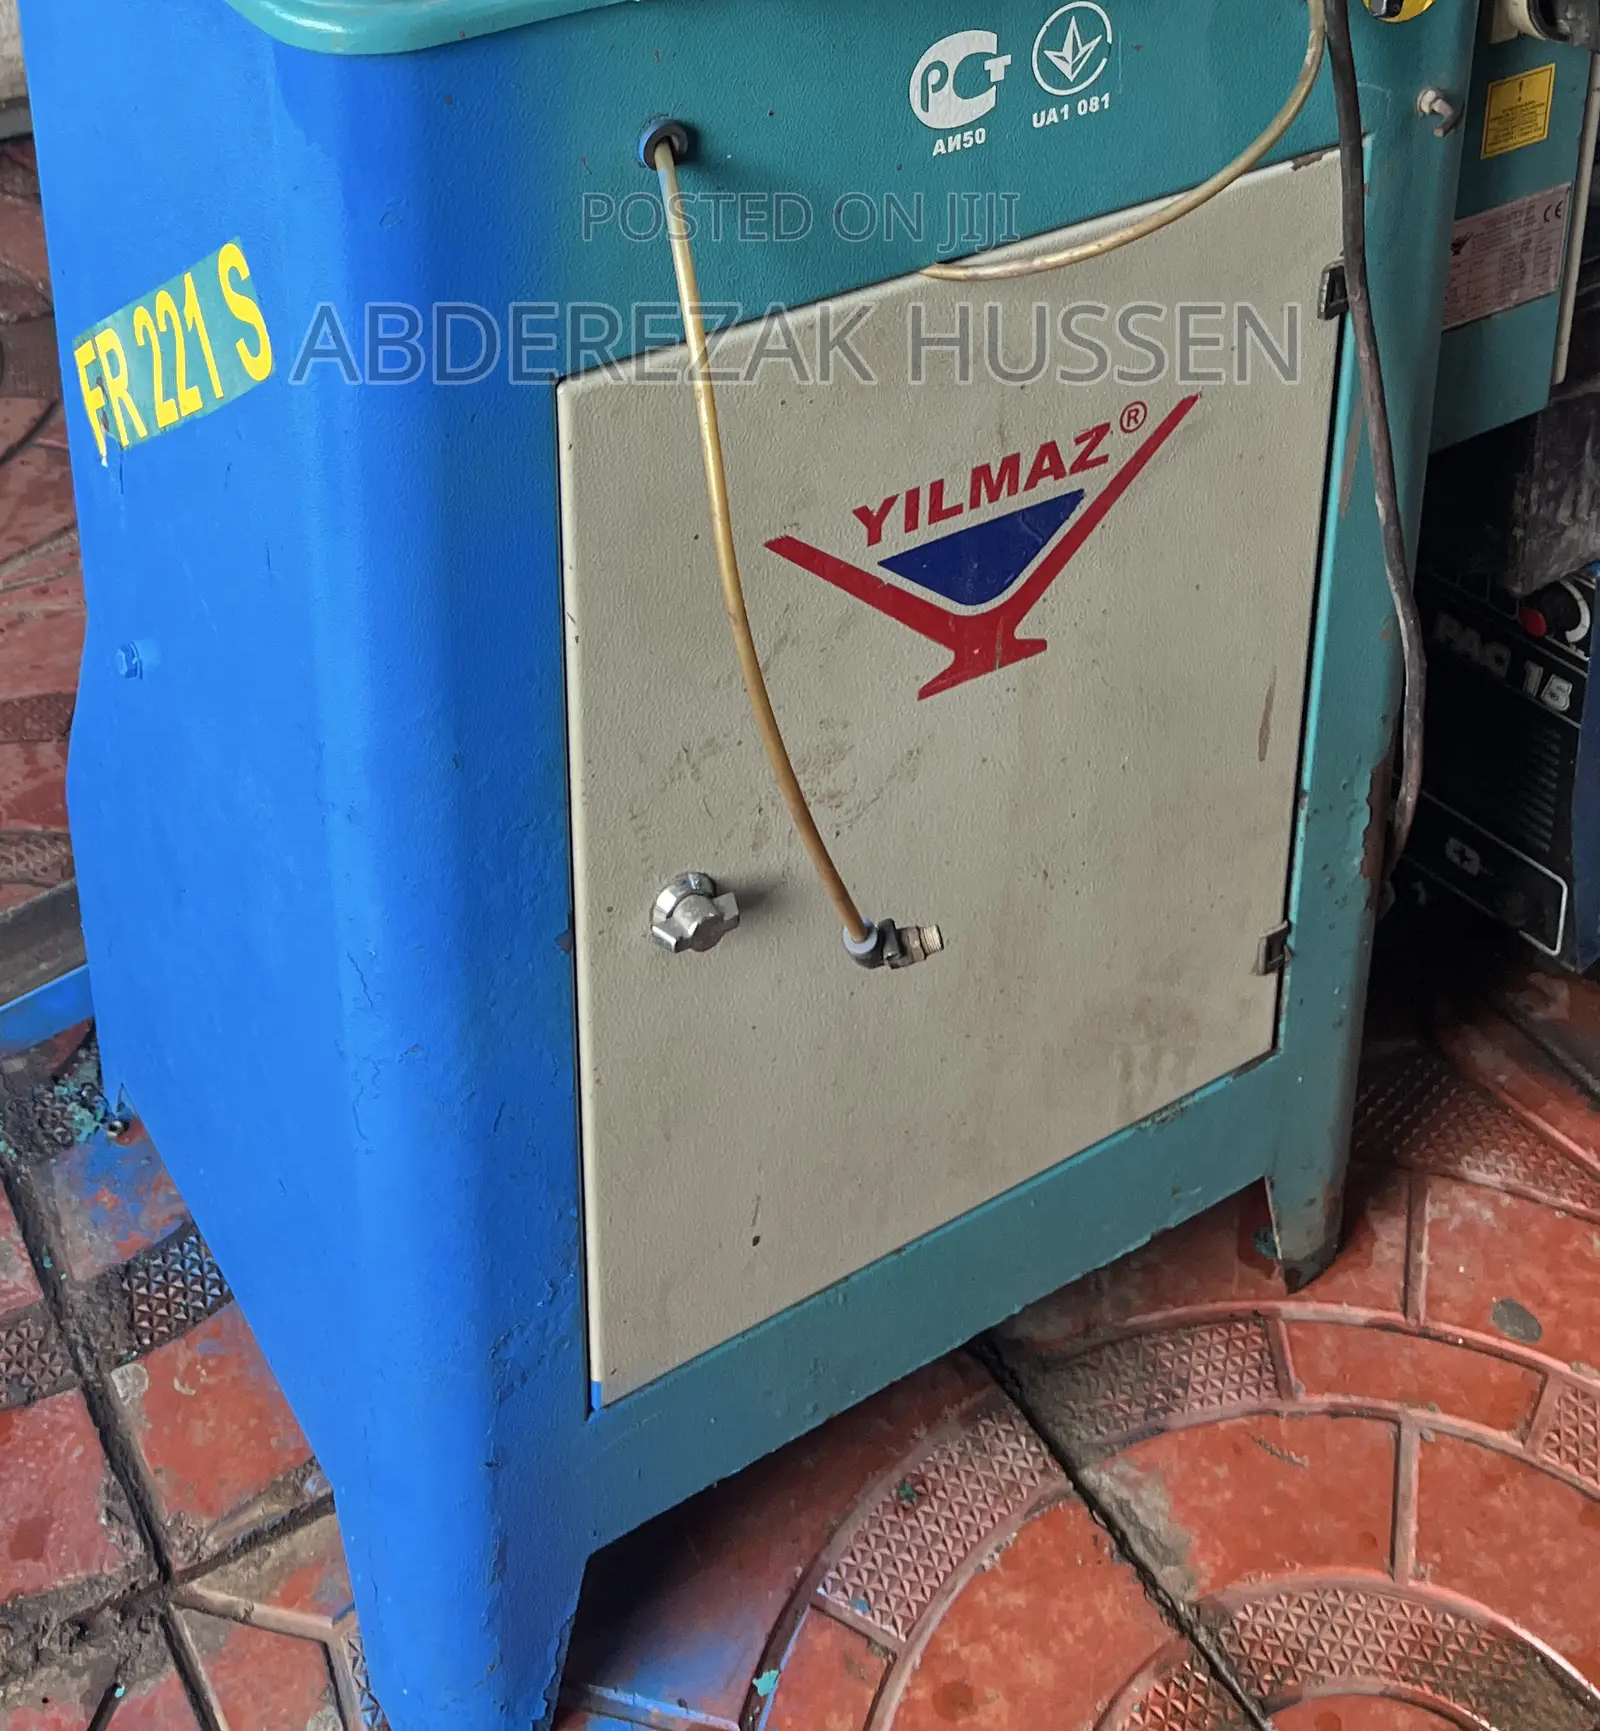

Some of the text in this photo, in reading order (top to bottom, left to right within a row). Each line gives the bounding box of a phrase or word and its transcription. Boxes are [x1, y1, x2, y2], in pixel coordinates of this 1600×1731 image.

[1032, 92, 1112, 129] UA1 081
[74, 242, 273, 460] FR 221 S
[852, 422, 1112, 548] YILMAZ
